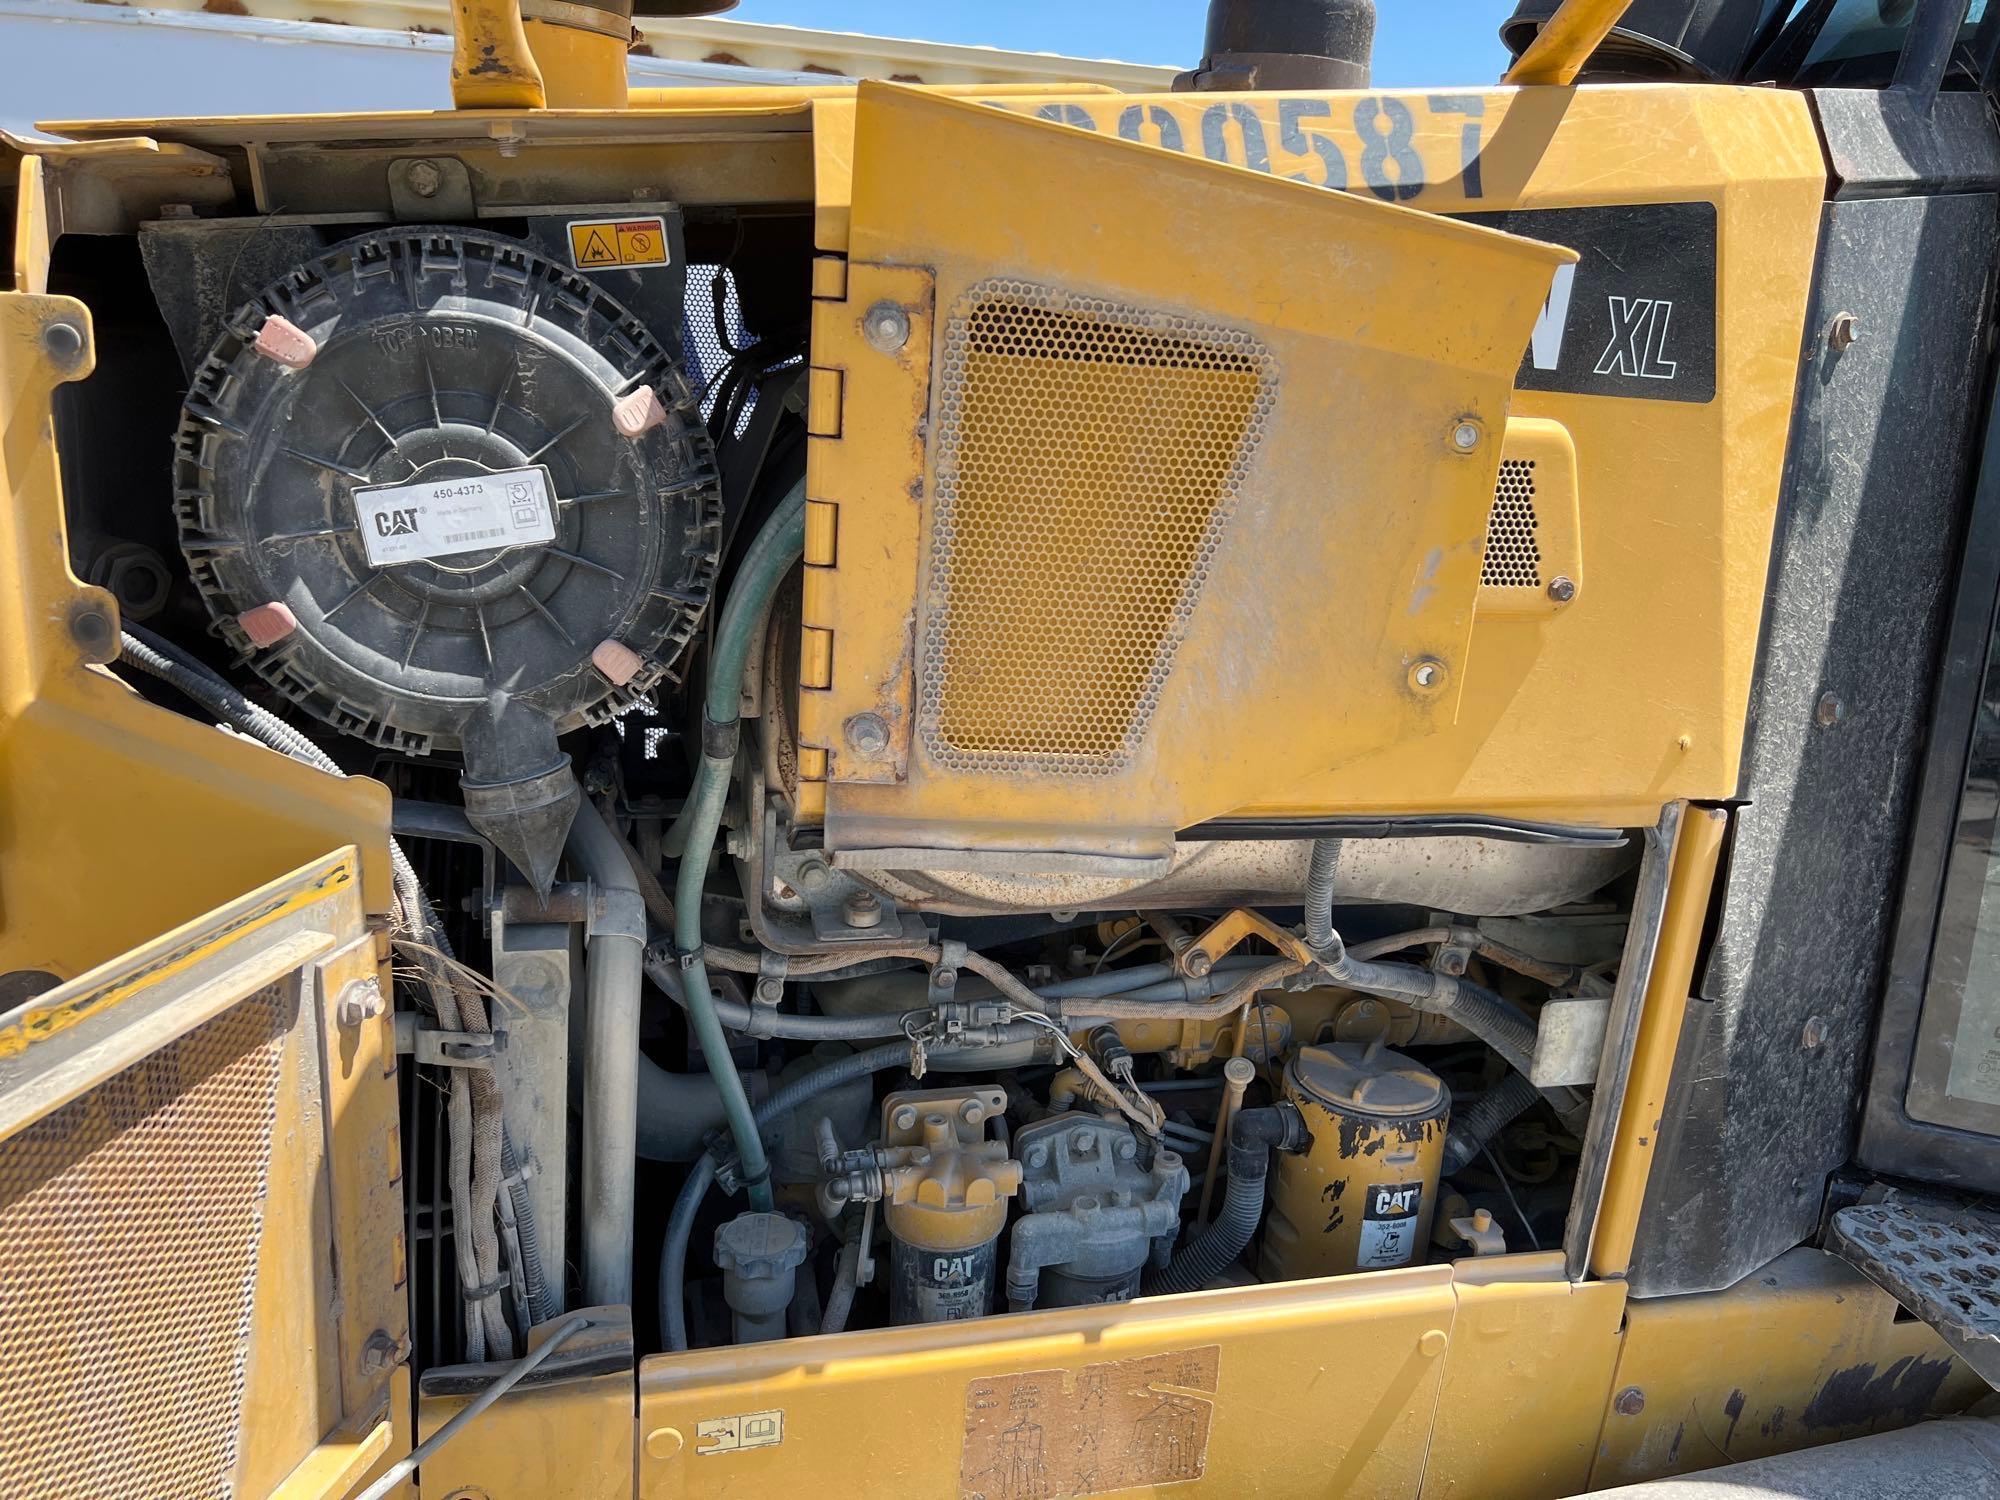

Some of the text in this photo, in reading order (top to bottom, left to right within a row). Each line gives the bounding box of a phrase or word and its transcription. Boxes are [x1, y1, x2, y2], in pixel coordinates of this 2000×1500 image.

[626, 223, 660, 232] WARNING
[1593, 295, 1677, 380] XL
[433, 484, 484, 500] 450-4373
[933, 1254, 975, 1282] CAT
